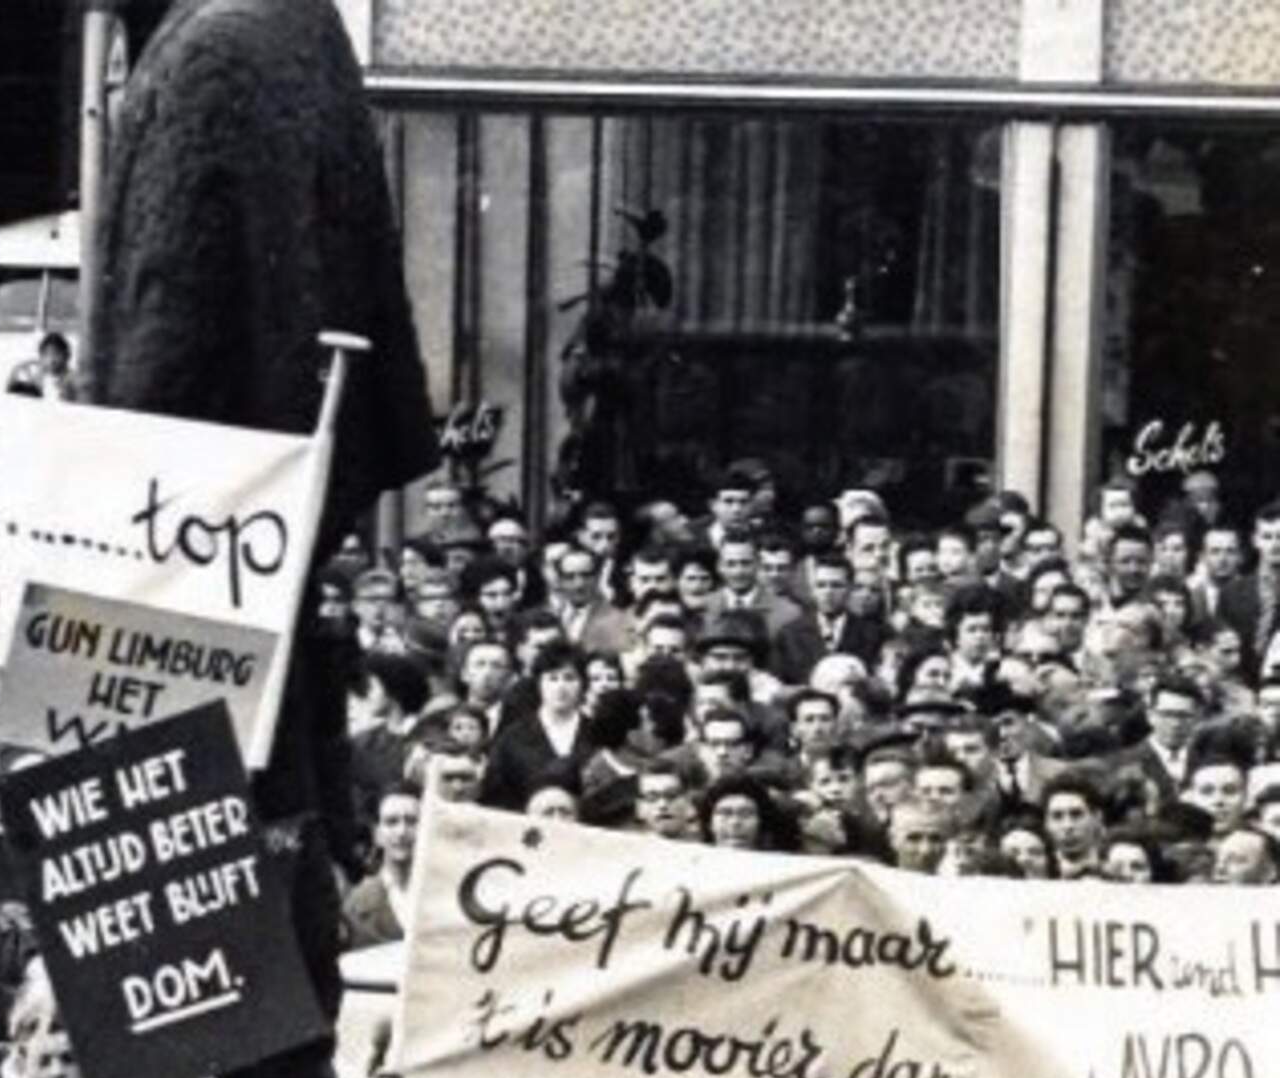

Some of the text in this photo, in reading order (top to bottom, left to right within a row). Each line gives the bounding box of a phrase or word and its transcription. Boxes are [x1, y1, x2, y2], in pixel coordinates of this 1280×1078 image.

[133, 478, 288, 609] top
[25, 612, 256, 687] GUN LIMBURG
[88, 671, 166, 719] HET
[30, 749, 187, 840] WIE HET
[42, 795, 249, 902] ALTIJD BETER
[59, 855, 260, 959] WEET BLIJFT
[458, 857, 651, 973] Geef
[518, 988, 584, 1062] is
